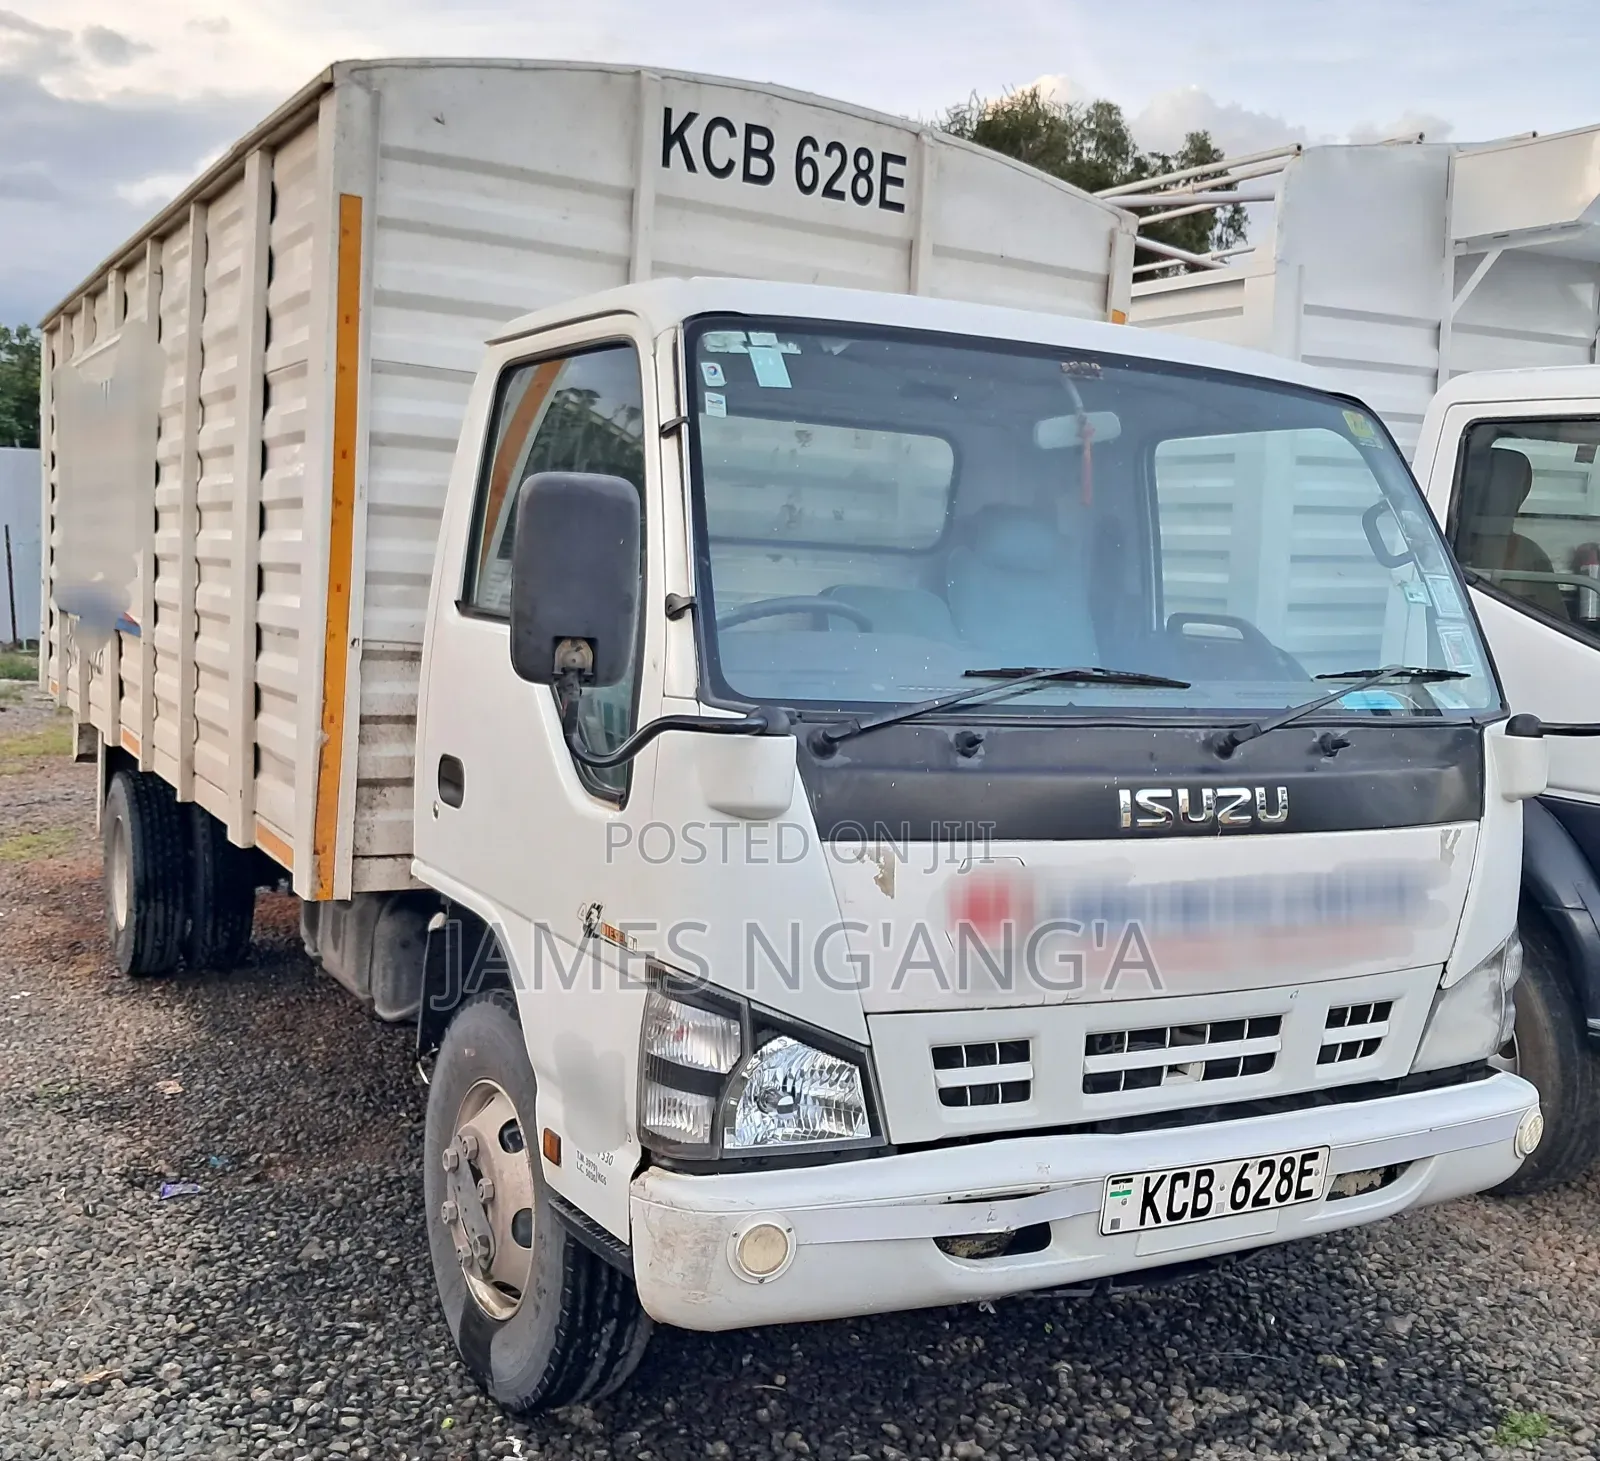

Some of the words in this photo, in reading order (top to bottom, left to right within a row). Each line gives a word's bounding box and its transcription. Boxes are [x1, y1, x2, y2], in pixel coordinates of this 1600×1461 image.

[661, 107, 776, 187] KCB
[795, 135, 907, 214] 628E
[1118, 786, 1289, 828] ISUZU
[1139, 1168, 1215, 1226] KCB
[1230, 1151, 1320, 1211] 628E
